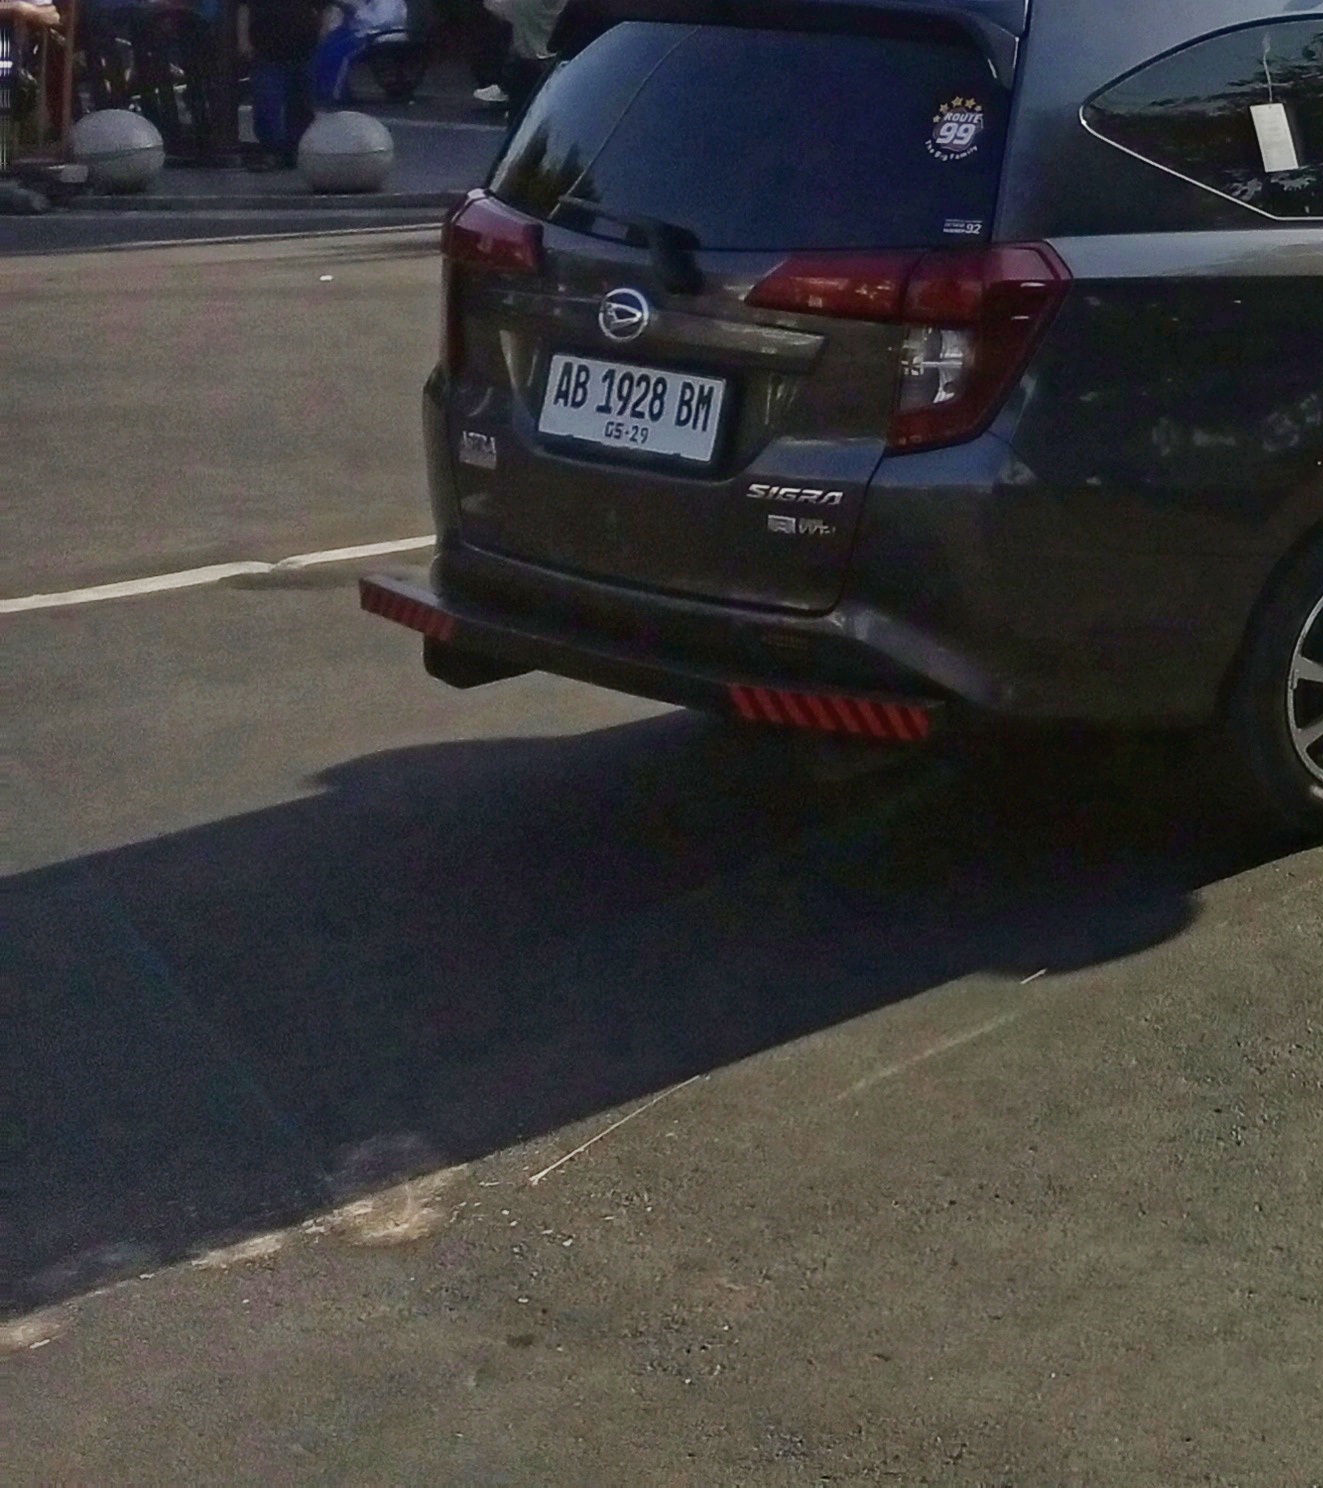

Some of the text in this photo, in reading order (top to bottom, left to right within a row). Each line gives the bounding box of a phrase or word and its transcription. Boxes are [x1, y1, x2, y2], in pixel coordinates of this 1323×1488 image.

[944, 112, 983, 124] ROUTE
[936, 122, 976, 145] 99
[553, 361, 714, 432] AB 1928 BM
[746, 483, 843, 505] SIGRA
